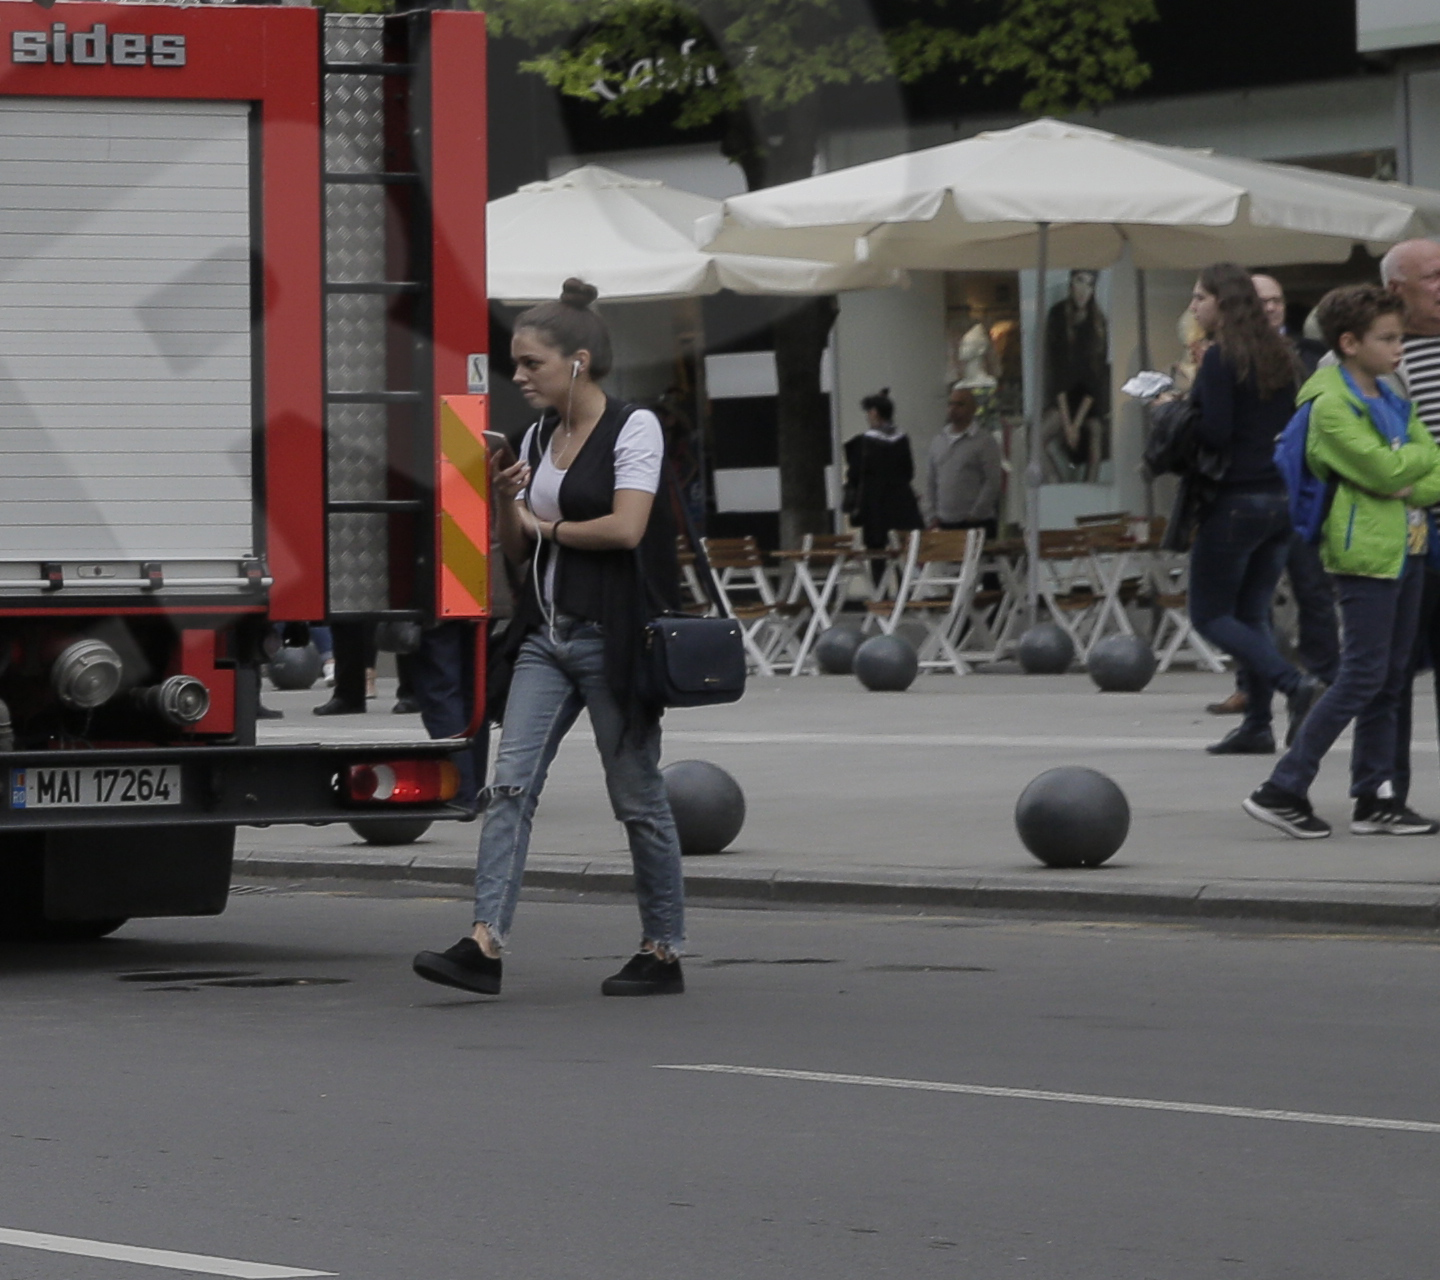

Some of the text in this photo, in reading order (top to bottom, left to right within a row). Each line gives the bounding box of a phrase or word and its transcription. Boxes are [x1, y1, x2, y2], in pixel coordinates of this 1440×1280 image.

[11, 22, 186, 67] sides
[36, 768, 170, 803] MAI 17264
